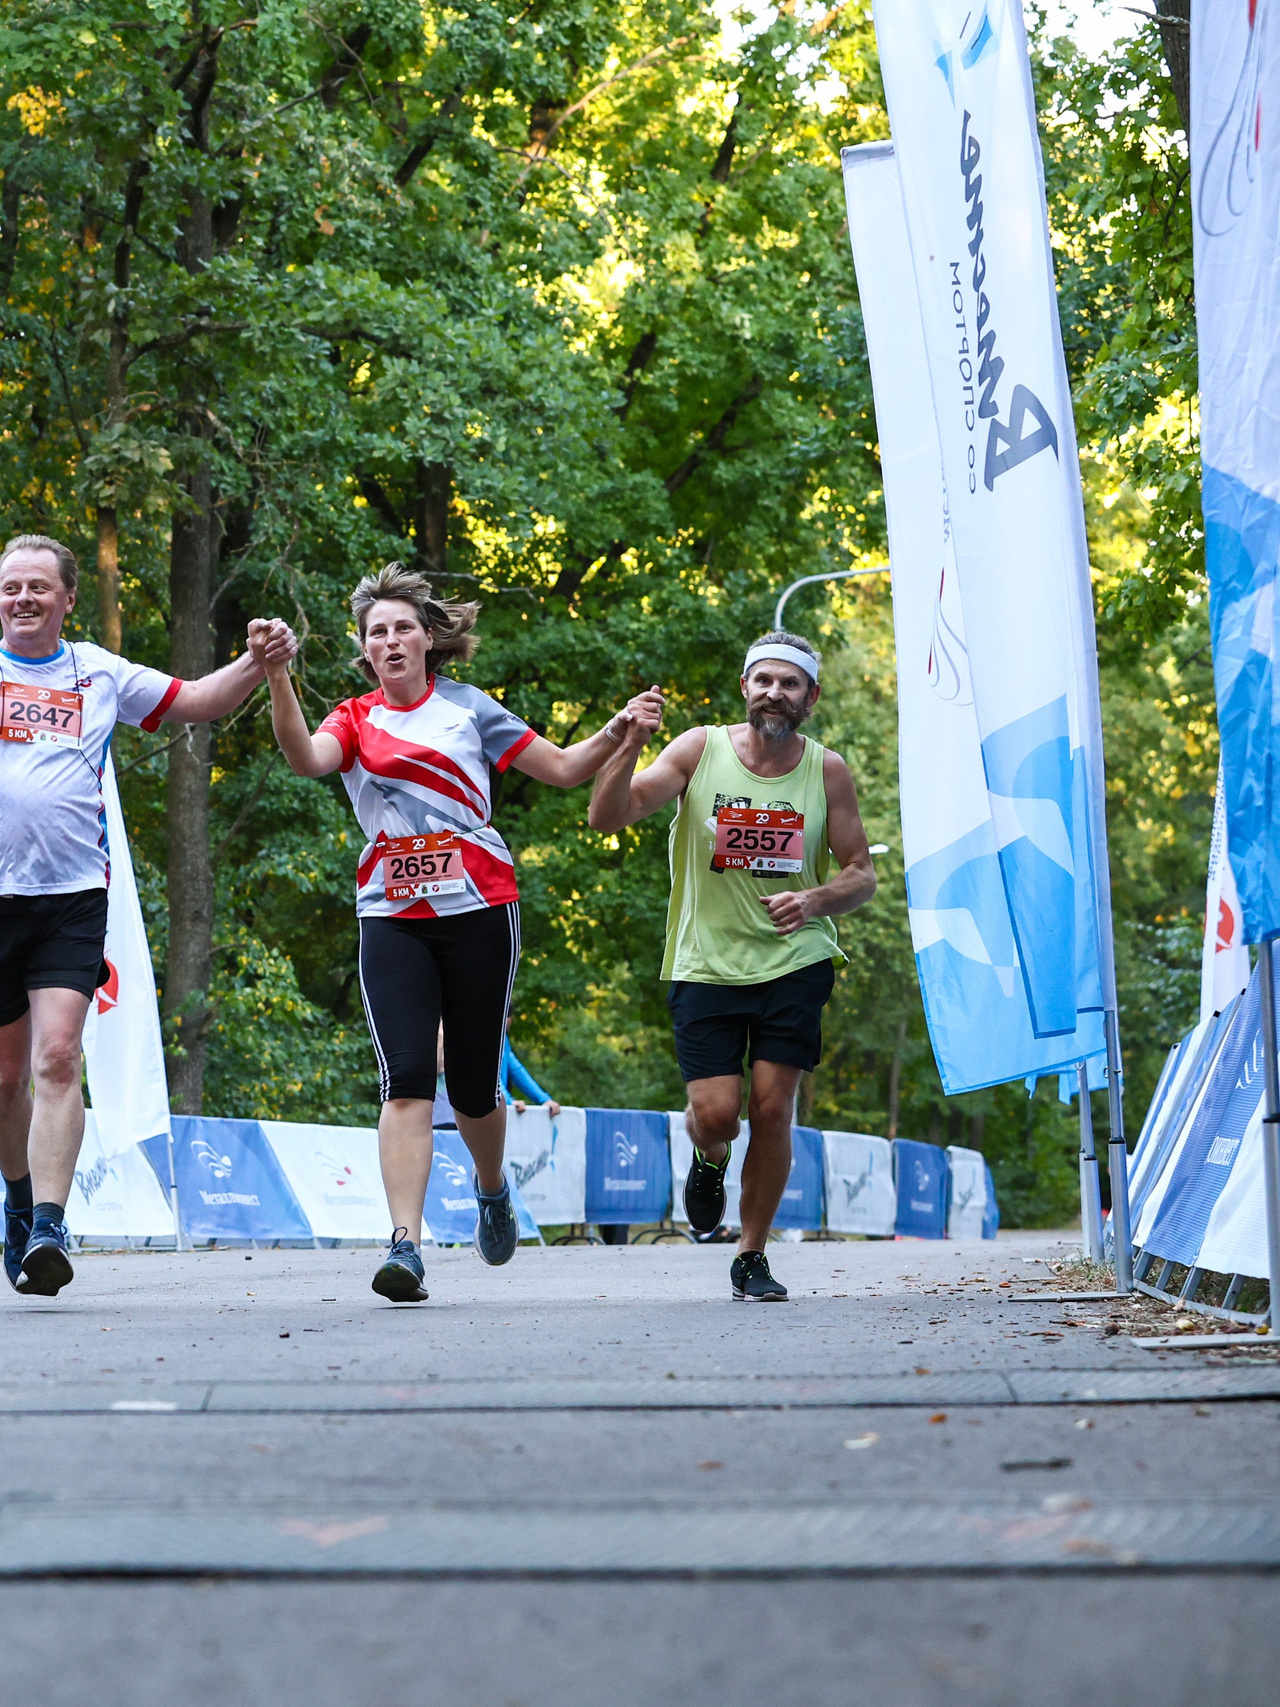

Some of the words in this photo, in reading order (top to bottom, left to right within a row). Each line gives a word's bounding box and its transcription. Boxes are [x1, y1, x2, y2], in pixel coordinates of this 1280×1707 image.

[9, 701, 74, 728] 2647
[8, 729, 14, 738] 5
[15, 730, 27, 739] KM
[726, 828, 794, 852] 2557
[390, 852, 453, 880] 2657
[725, 857, 730, 866] 5
[732, 858, 744, 867] KM
[392, 889, 398, 898] 5
[399, 887, 410, 897] KM
